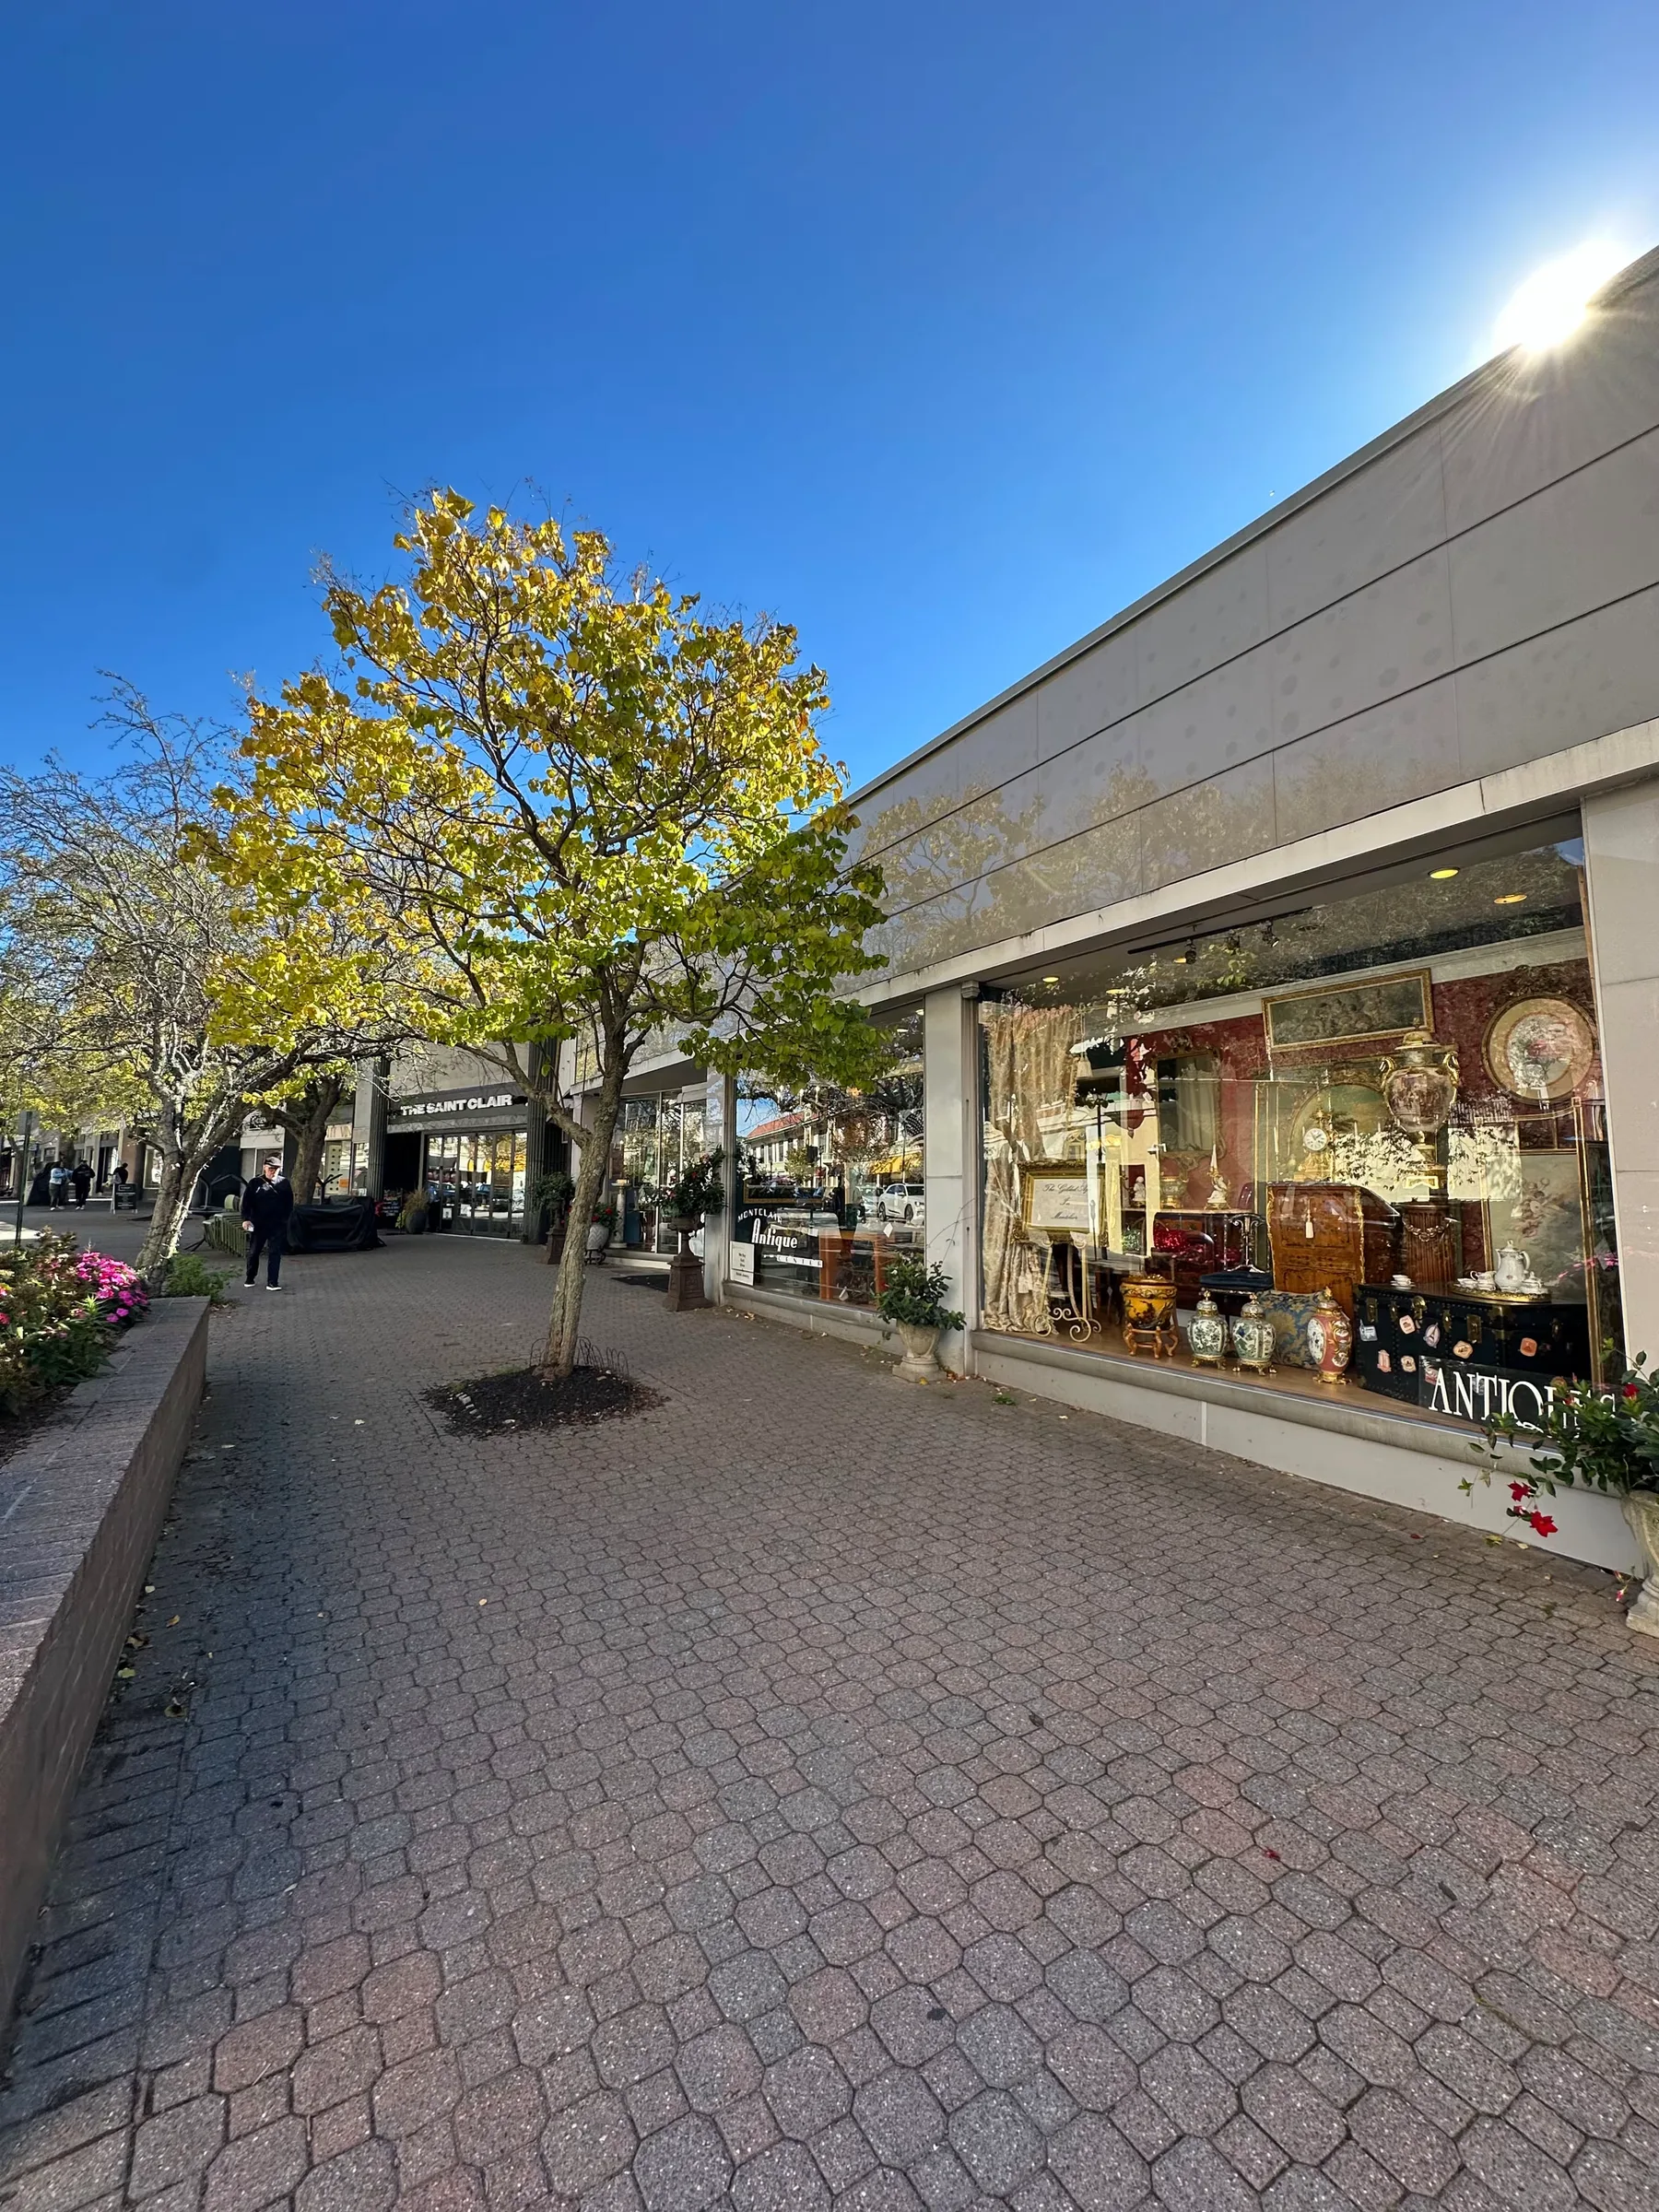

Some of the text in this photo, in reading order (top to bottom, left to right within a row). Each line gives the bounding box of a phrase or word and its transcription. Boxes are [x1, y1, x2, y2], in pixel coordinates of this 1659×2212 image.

[400, 1094, 512, 1116] THE SAINT CLAIR
[737, 1208, 782, 1225] MONTCLAIR
[751, 1218, 798, 1253] Antique
